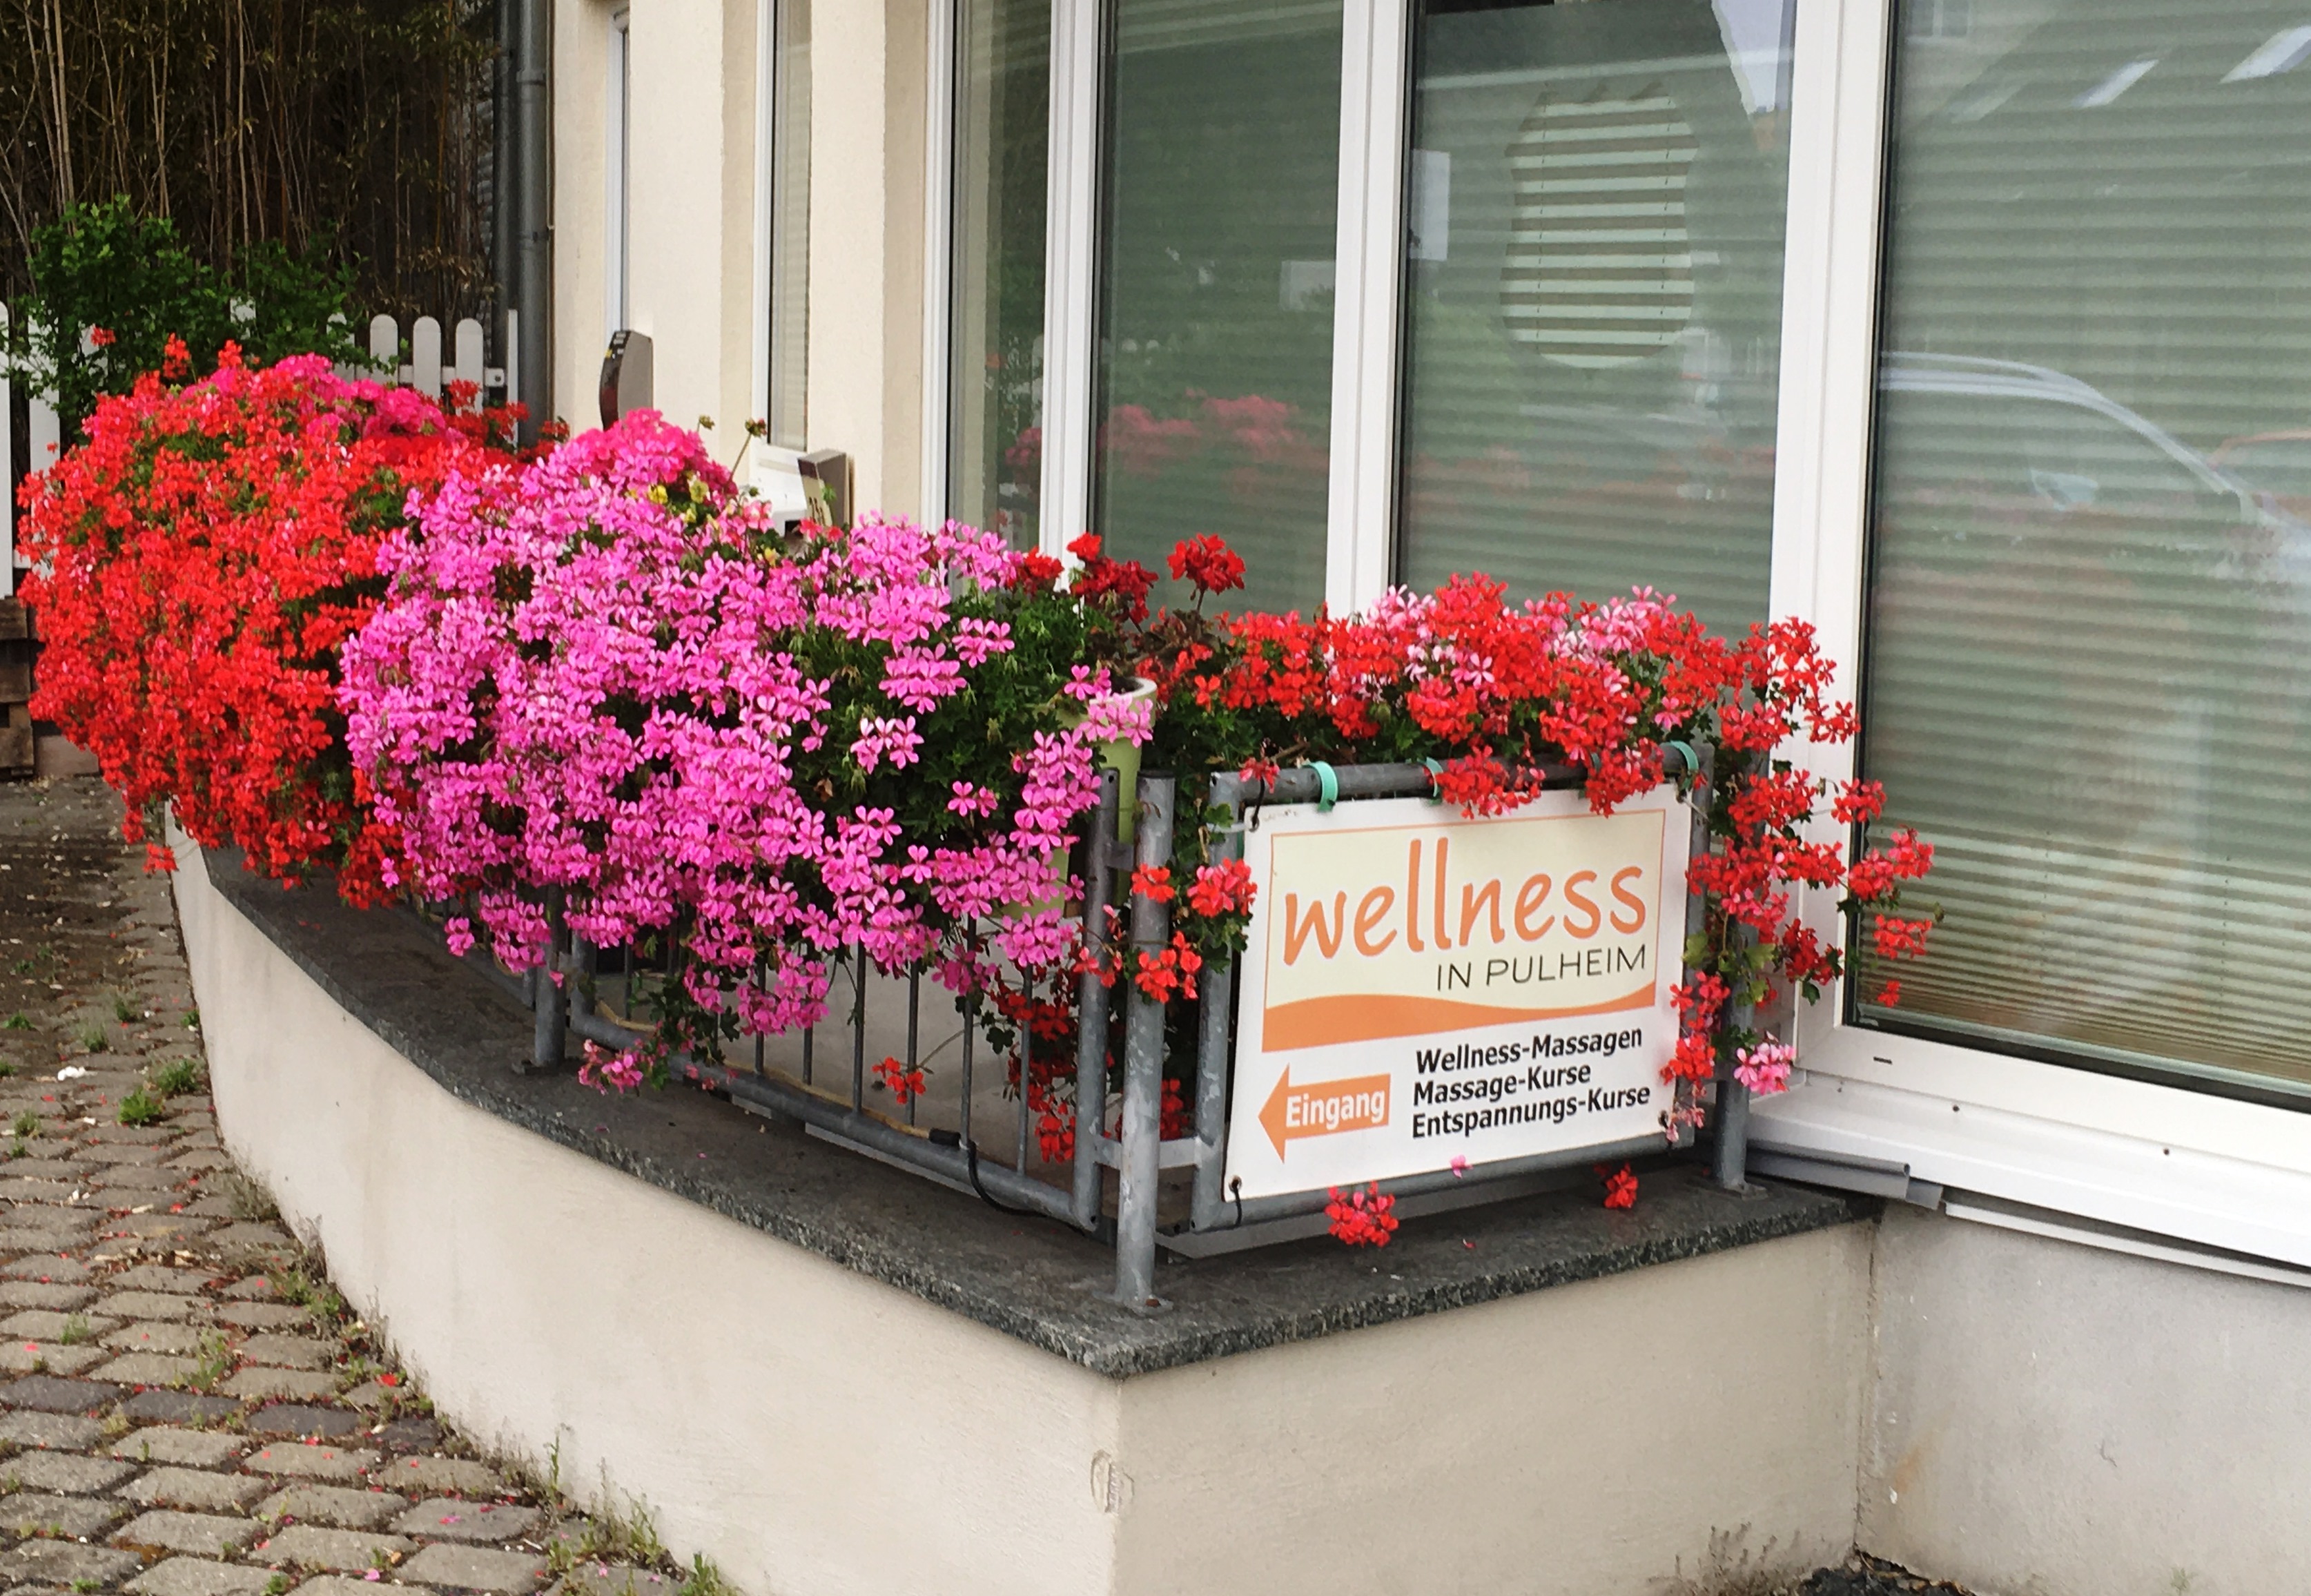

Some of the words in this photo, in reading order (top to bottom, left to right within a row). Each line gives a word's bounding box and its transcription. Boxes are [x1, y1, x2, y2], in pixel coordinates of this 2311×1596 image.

[1284, 837, 1647, 966] wellness
[1437, 962, 1472, 991] IN
[1485, 944, 1646, 987] PULHEIM
[1416, 1027, 1643, 1074] Wellness-Massagen
[1412, 1062, 1591, 1107] Massage-Kurse
[1286, 1089, 1385, 1131] Eingang
[1412, 1084, 1651, 1138] Entspannungs-Kurse
